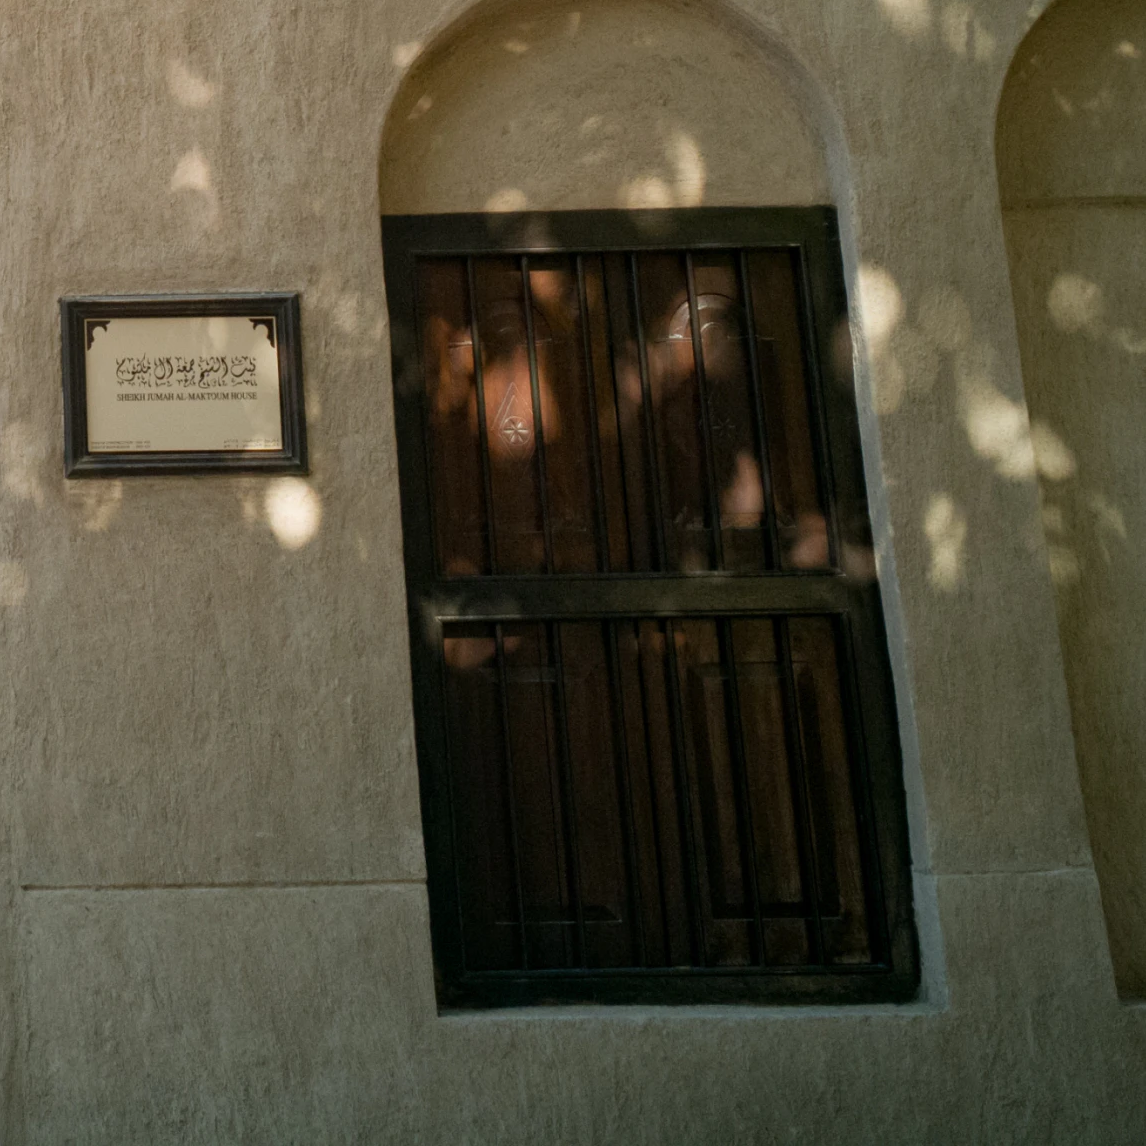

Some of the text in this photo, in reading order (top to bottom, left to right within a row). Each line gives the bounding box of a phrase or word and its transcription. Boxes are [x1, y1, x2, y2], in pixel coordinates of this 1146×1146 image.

[116, 391, 258, 402] SHEIKH JUMAH AL-MAKTOUM HOUSE
